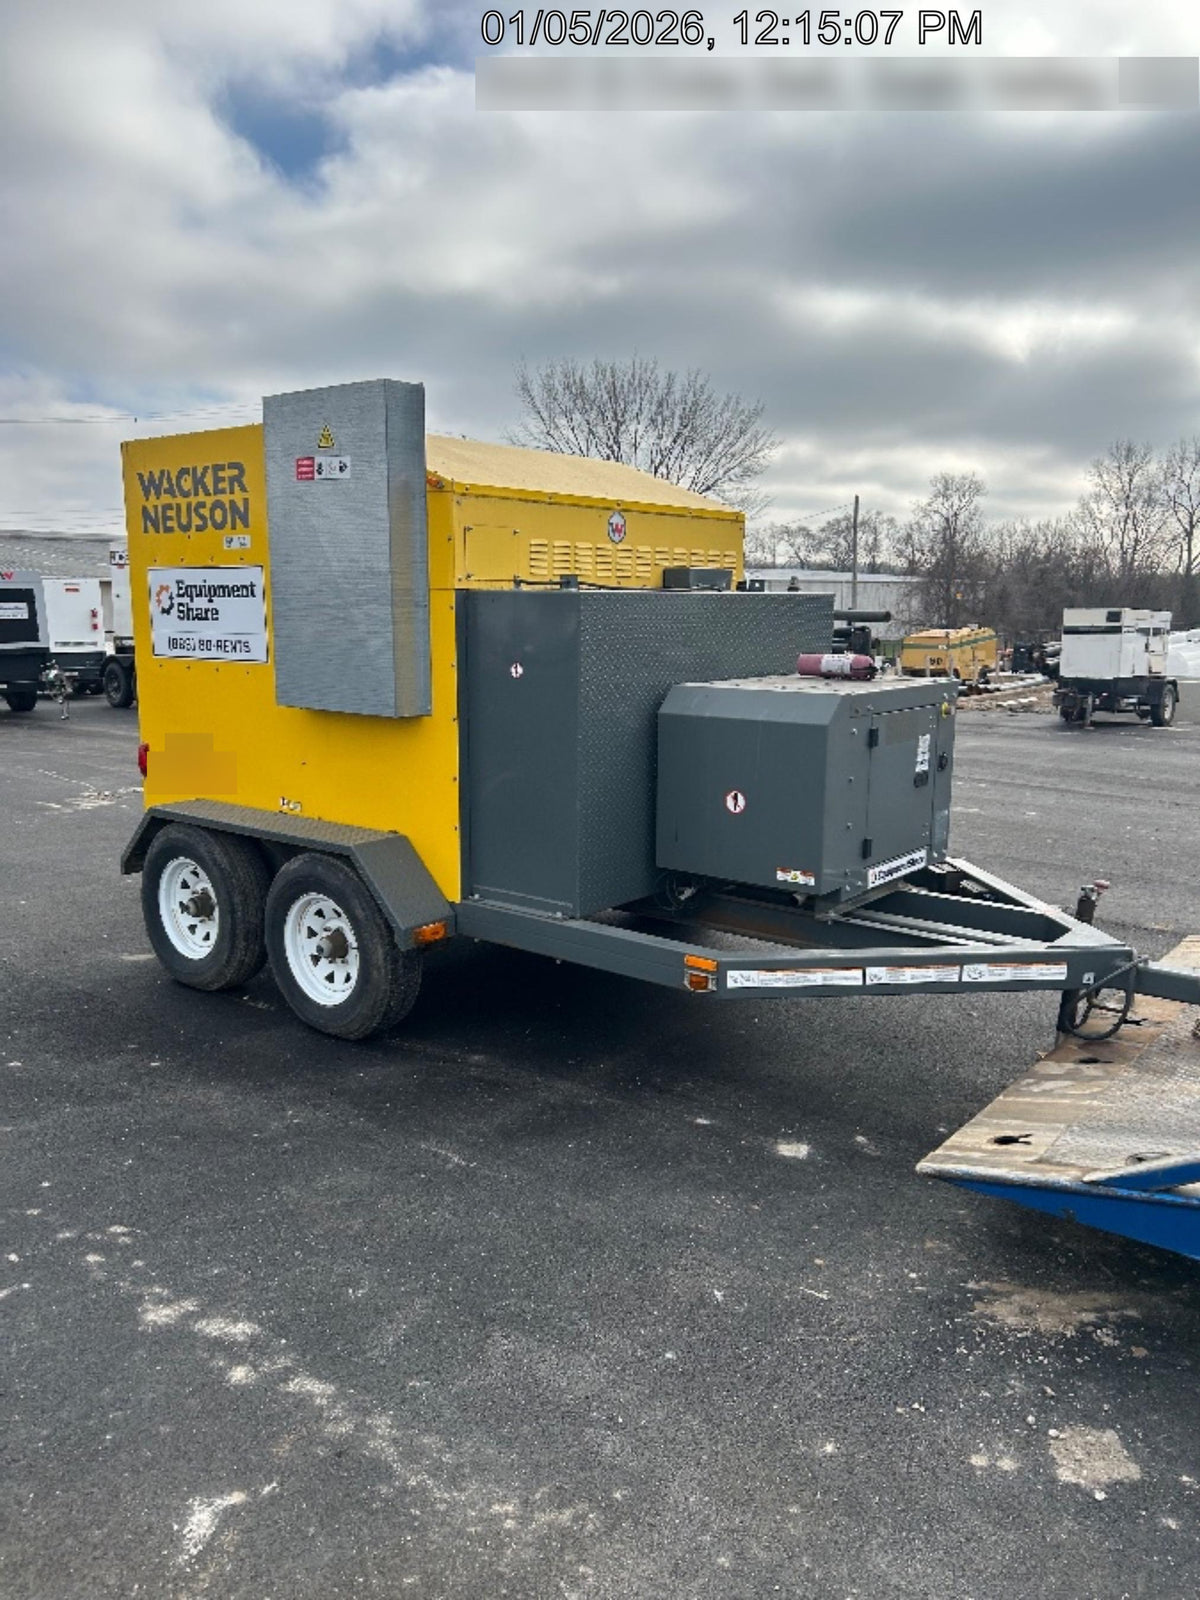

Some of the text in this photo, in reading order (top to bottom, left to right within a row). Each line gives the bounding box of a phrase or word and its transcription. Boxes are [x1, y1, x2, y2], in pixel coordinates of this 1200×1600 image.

[136, 461, 249, 501] WACKER
[141, 497, 250, 534] NEUSON
[175, 579, 257, 603] Equipment
[176, 602, 220, 621] Share
